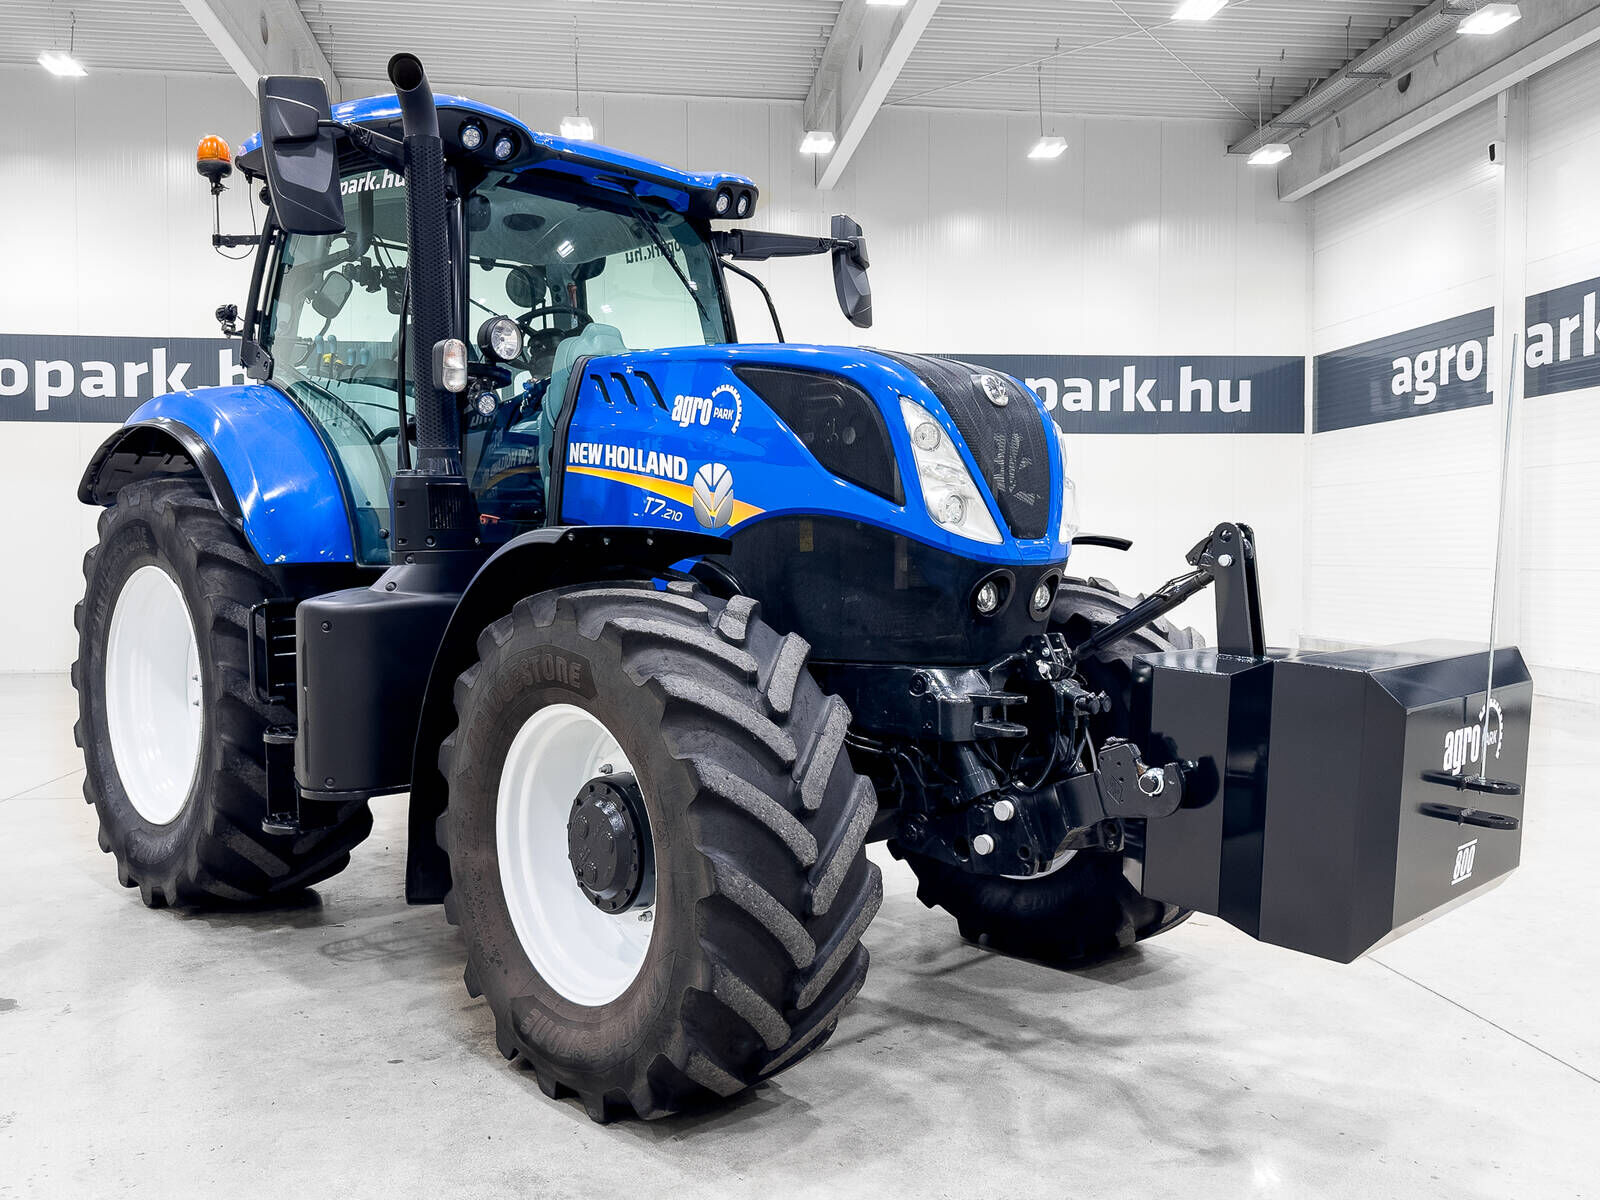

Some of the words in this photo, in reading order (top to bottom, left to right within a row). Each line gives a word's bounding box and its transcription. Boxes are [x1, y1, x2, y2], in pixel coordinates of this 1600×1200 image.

[1024, 365, 1251, 413] park.hu
[671, 394, 713, 428] agro
[712, 407, 735, 421] PARK
[569, 442, 603, 464] NEW
[604, 444, 688, 481] HOLLAND
[1443, 724, 1481, 776] agro
[1452, 844, 1476, 880] 800
